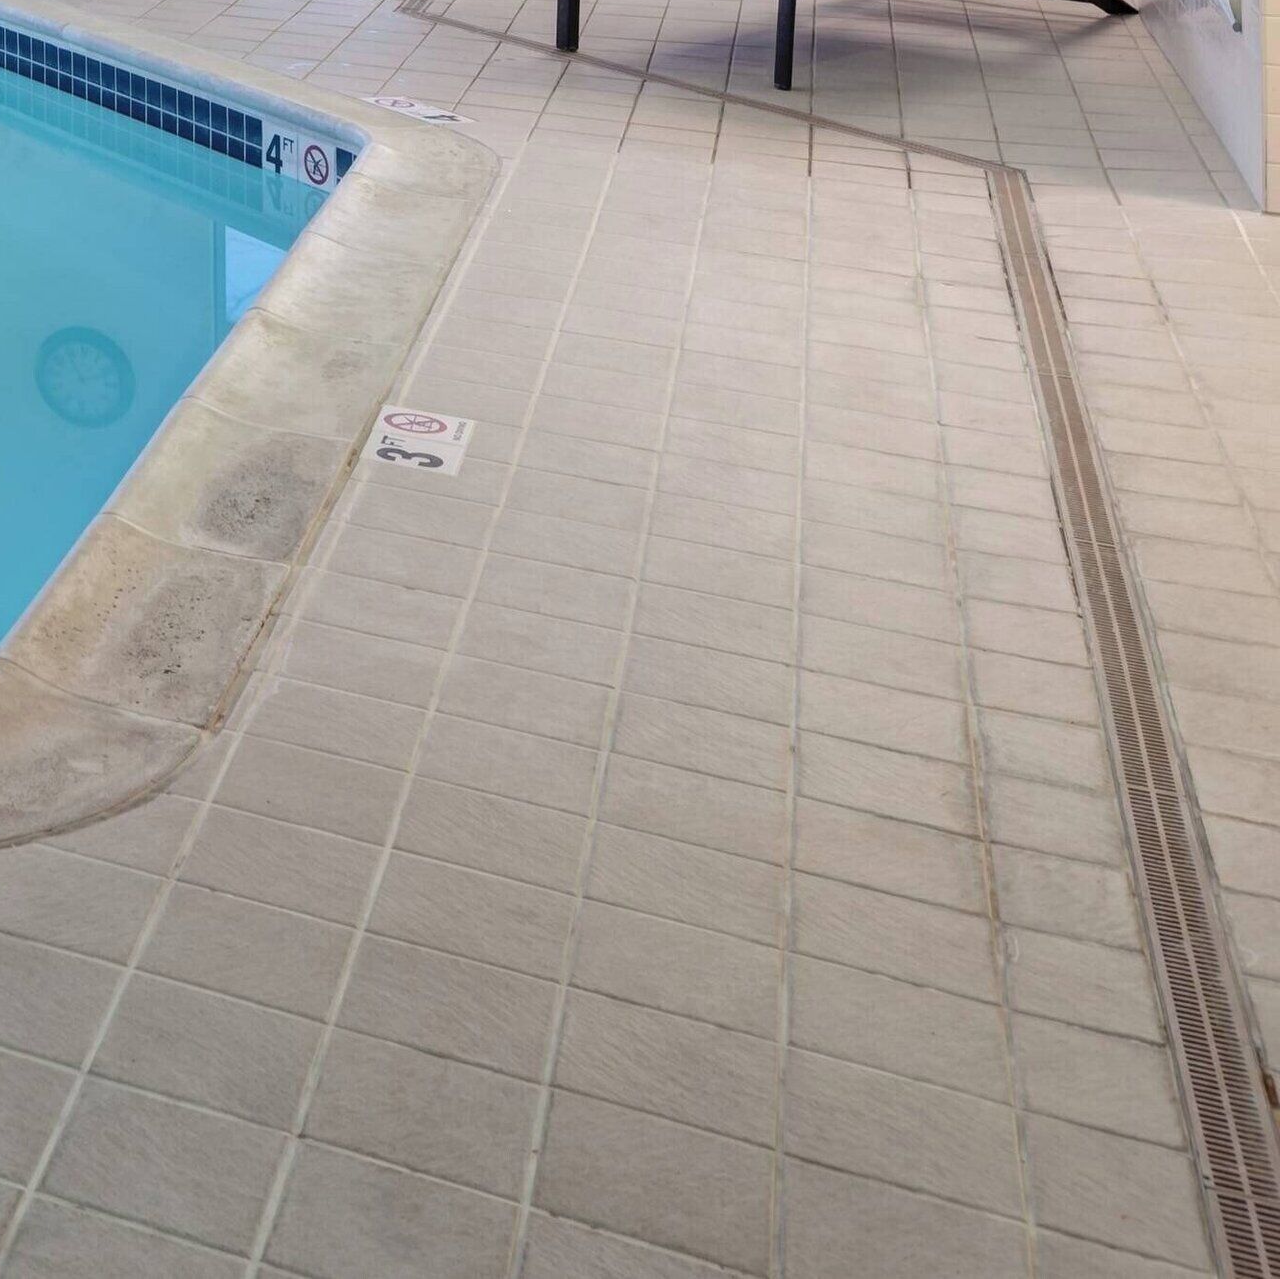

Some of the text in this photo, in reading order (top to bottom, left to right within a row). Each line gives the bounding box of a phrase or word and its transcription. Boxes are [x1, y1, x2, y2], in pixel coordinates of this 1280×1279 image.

[266, 134, 295, 174] 4 FT
[376, 435, 444, 468] 3 FT
